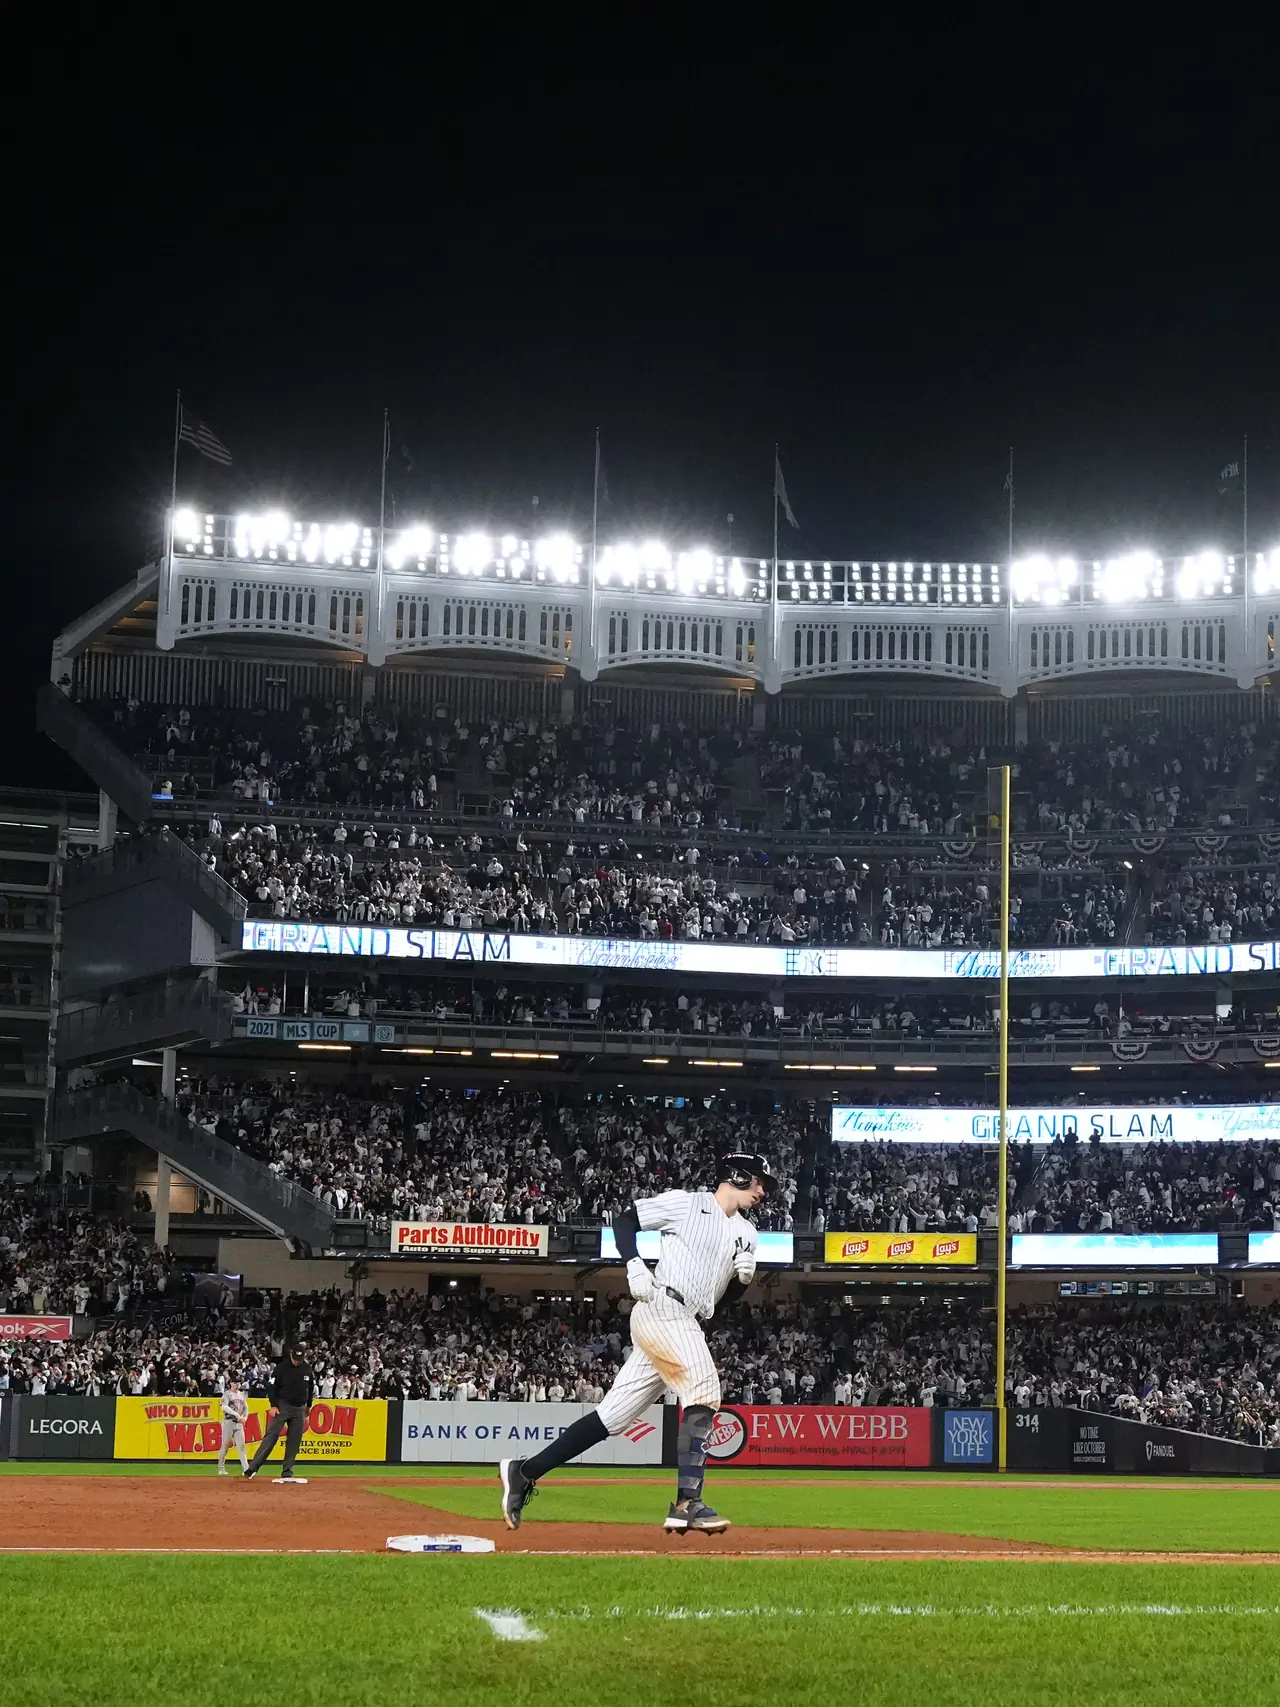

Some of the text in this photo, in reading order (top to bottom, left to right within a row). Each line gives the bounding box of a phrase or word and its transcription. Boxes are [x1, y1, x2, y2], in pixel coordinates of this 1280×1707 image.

[253, 922, 511, 960] GRAND SLAM
[1103, 944, 1234, 976] GRAND
[250, 1023, 337, 1038] 2021 MLS CUP
[972, 1114, 1173, 1138] GRAND SLAM
[399, 1224, 540, 1247] Parts Authority
[845, 1242, 867, 1255] Lay's
[891, 1242, 911, 1256] Lay's
[936, 1242, 957, 1256] Lay's
[145, 1405, 210, 1419] WHO BUT
[30, 1419, 103, 1435] LEGORA
[243, 1403, 358, 1445] MON
[751, 1413, 908, 1440] F.W. WEBB
[953, 1417, 985, 1431] NEW
[1016, 1414, 1039, 1427] 314
[408, 1425, 567, 1440] BANK OF AMER
[948, 1429, 988, 1444] YORK
[749, 1445, 796, 1455] Plumbing,
[953, 1442, 984, 1457] LIFE
